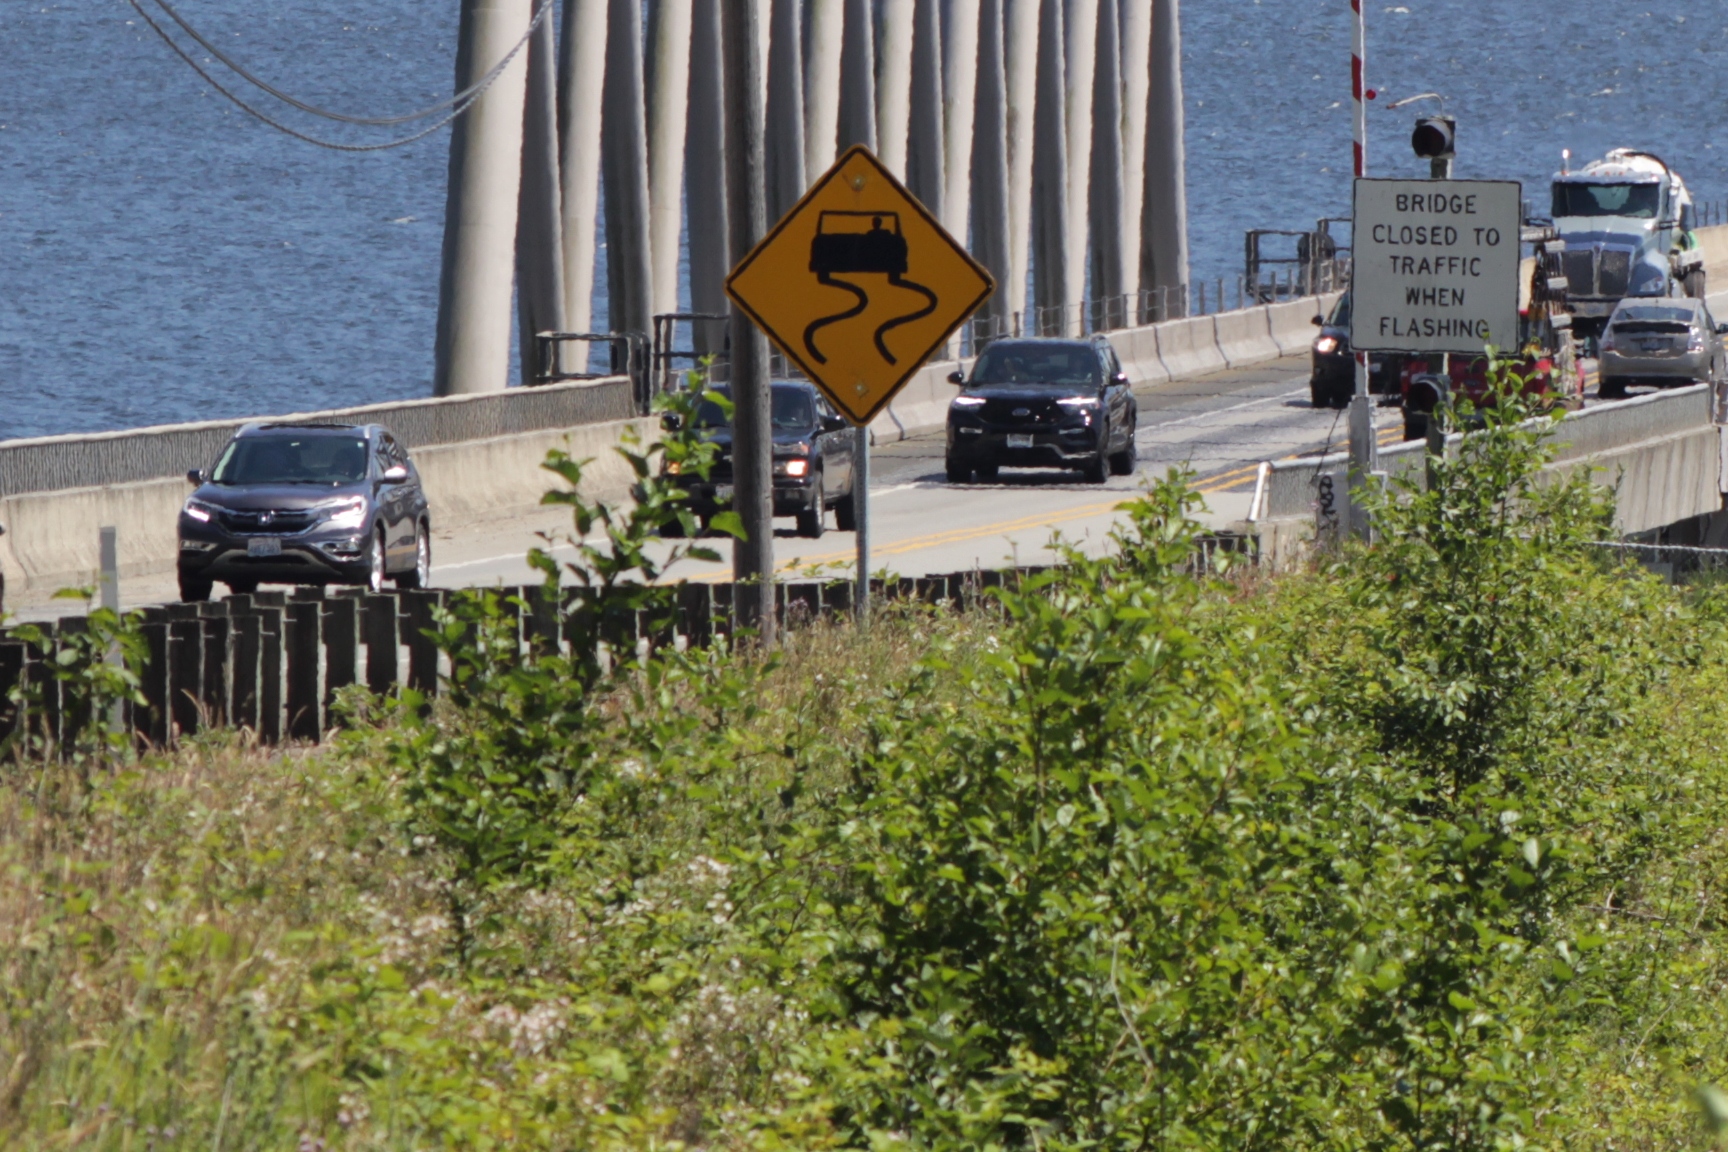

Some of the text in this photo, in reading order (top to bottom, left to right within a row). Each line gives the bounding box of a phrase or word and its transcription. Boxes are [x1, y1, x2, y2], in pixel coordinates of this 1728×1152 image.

[1396, 194, 1477, 214] BRIDGE
[1372, 224, 1501, 246] CLOSED TO
[1389, 255, 1482, 277] TRAFFIC
[1406, 287, 1465, 307] WHEN
[1379, 316, 1490, 340] FLASHING
